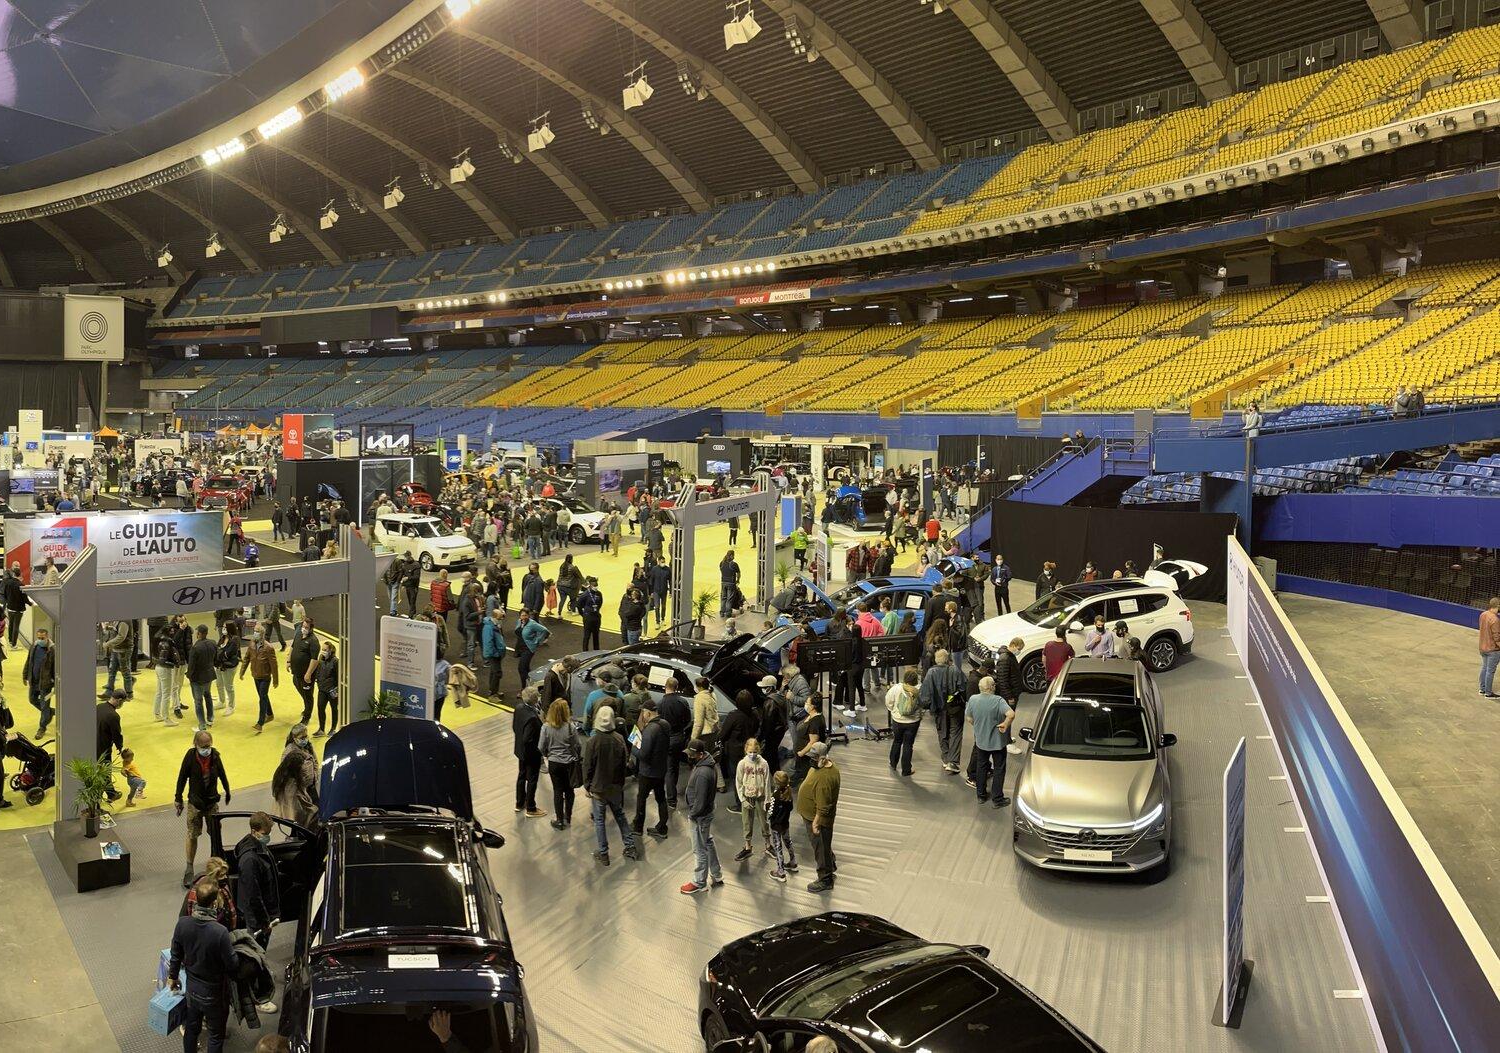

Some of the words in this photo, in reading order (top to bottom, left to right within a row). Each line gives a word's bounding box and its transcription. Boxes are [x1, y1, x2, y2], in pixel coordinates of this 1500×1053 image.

[109, 531, 121, 540] LE
[122, 521, 178, 539] GUIDE
[123, 548, 136, 556] DE
[136, 537, 197, 555] L'AUTO
[210, 578, 288, 600] HYUNDAI
